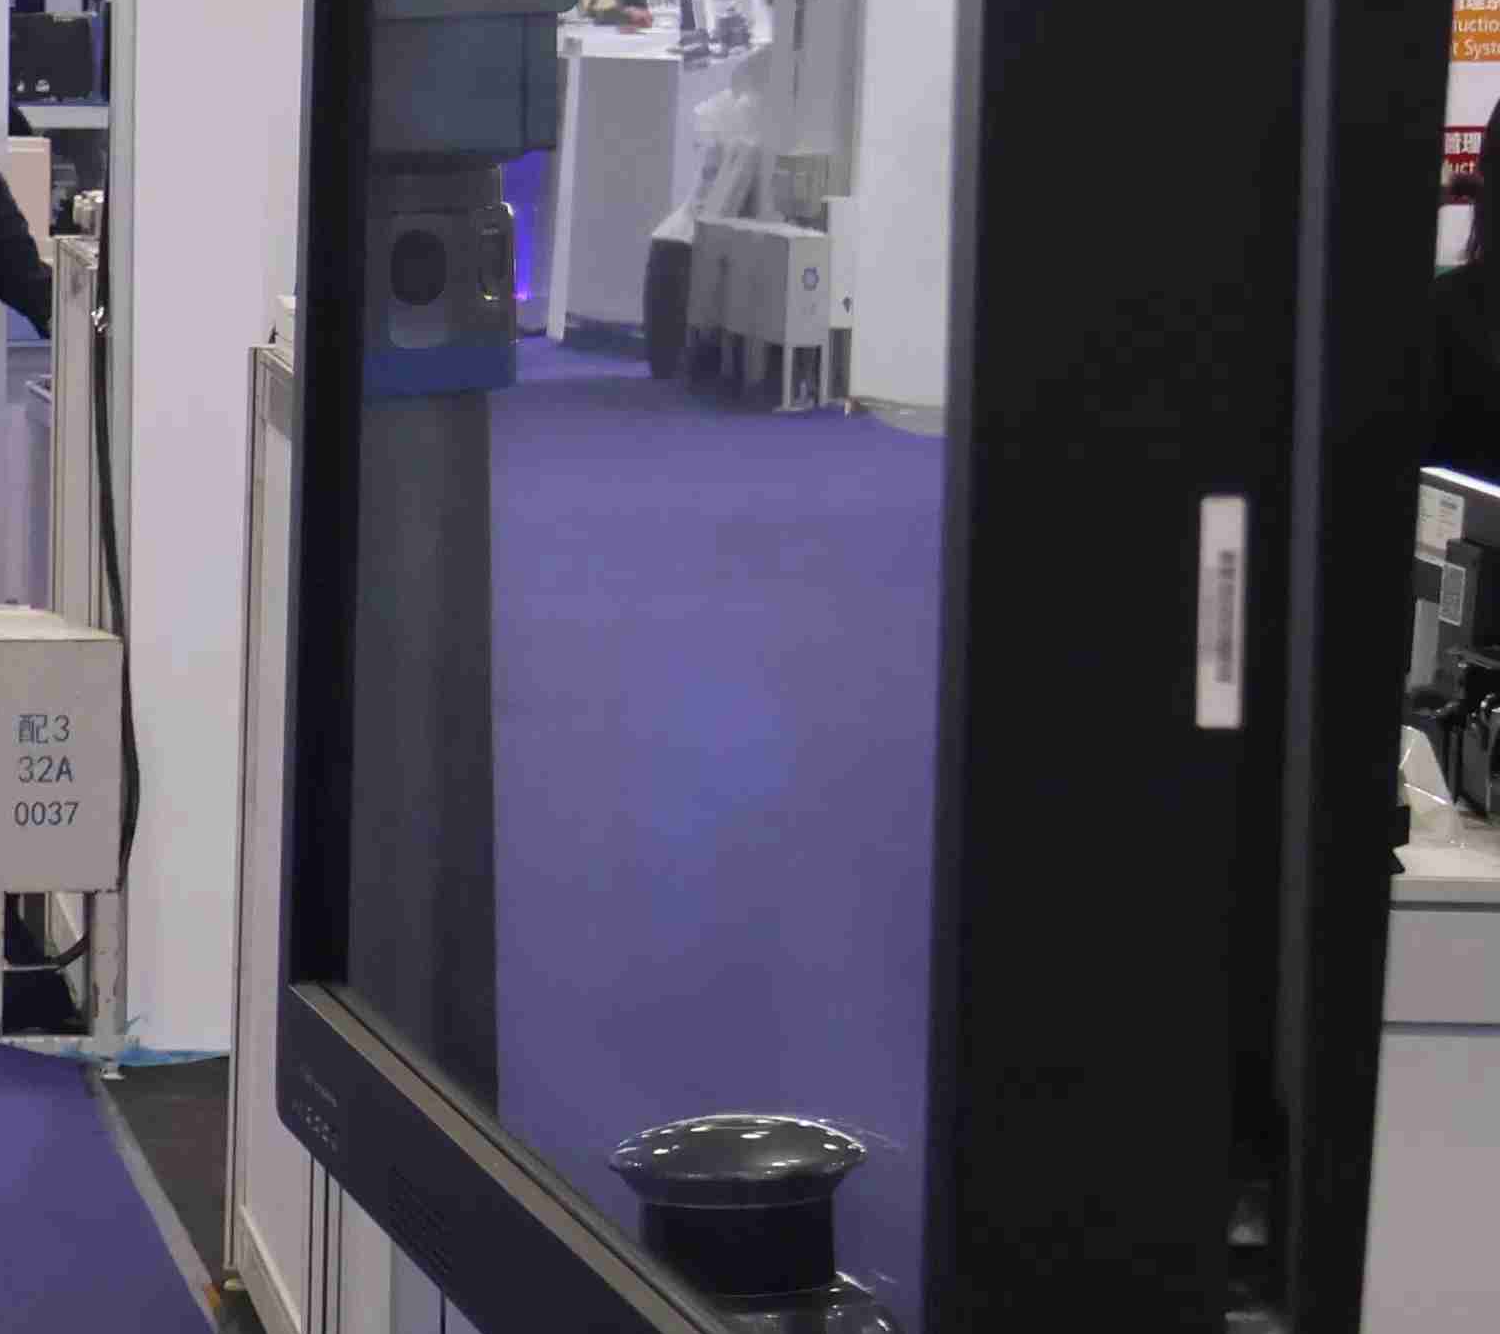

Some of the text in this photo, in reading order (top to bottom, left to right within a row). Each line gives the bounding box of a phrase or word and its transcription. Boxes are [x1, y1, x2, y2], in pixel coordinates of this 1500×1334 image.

[17, 713, 71, 744] 配3
[18, 756, 74, 784] 32A
[13, 801, 79, 827] 0037
